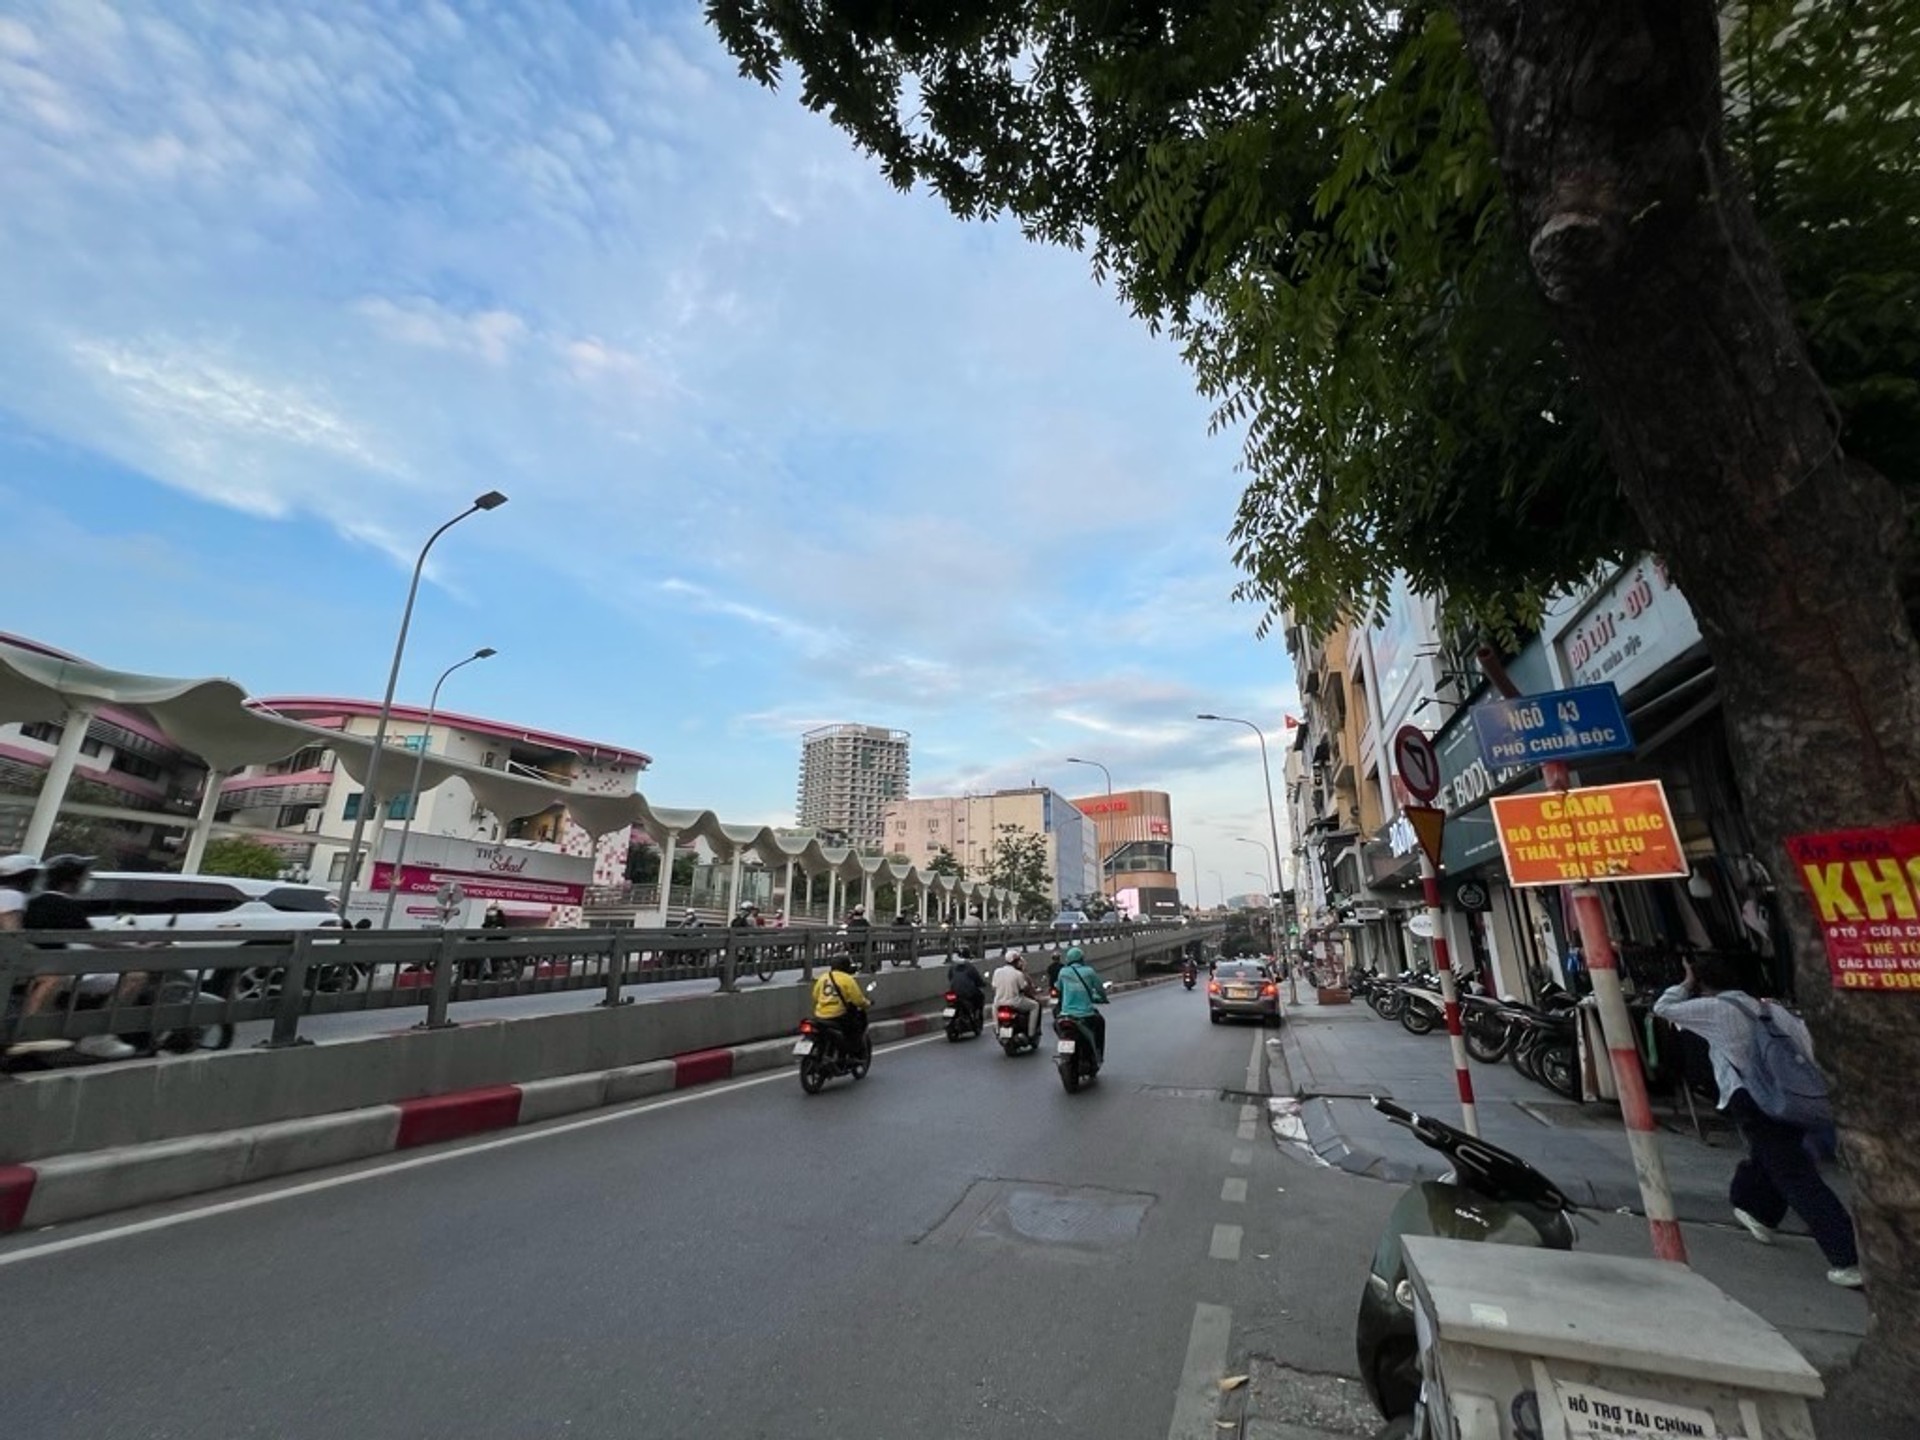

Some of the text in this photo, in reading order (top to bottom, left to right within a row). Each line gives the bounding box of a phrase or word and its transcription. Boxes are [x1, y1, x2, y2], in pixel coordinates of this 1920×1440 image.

[1557, 700, 1580, 723] 43
[1492, 727, 1616, 758] PHỐ CHÙA BỘC
[1624, 812, 1664, 832] RÁC
[489, 853, 528, 873] School
[1803, 857, 1920, 922] KH
[1625, 1408, 1651, 1428] TÀI
